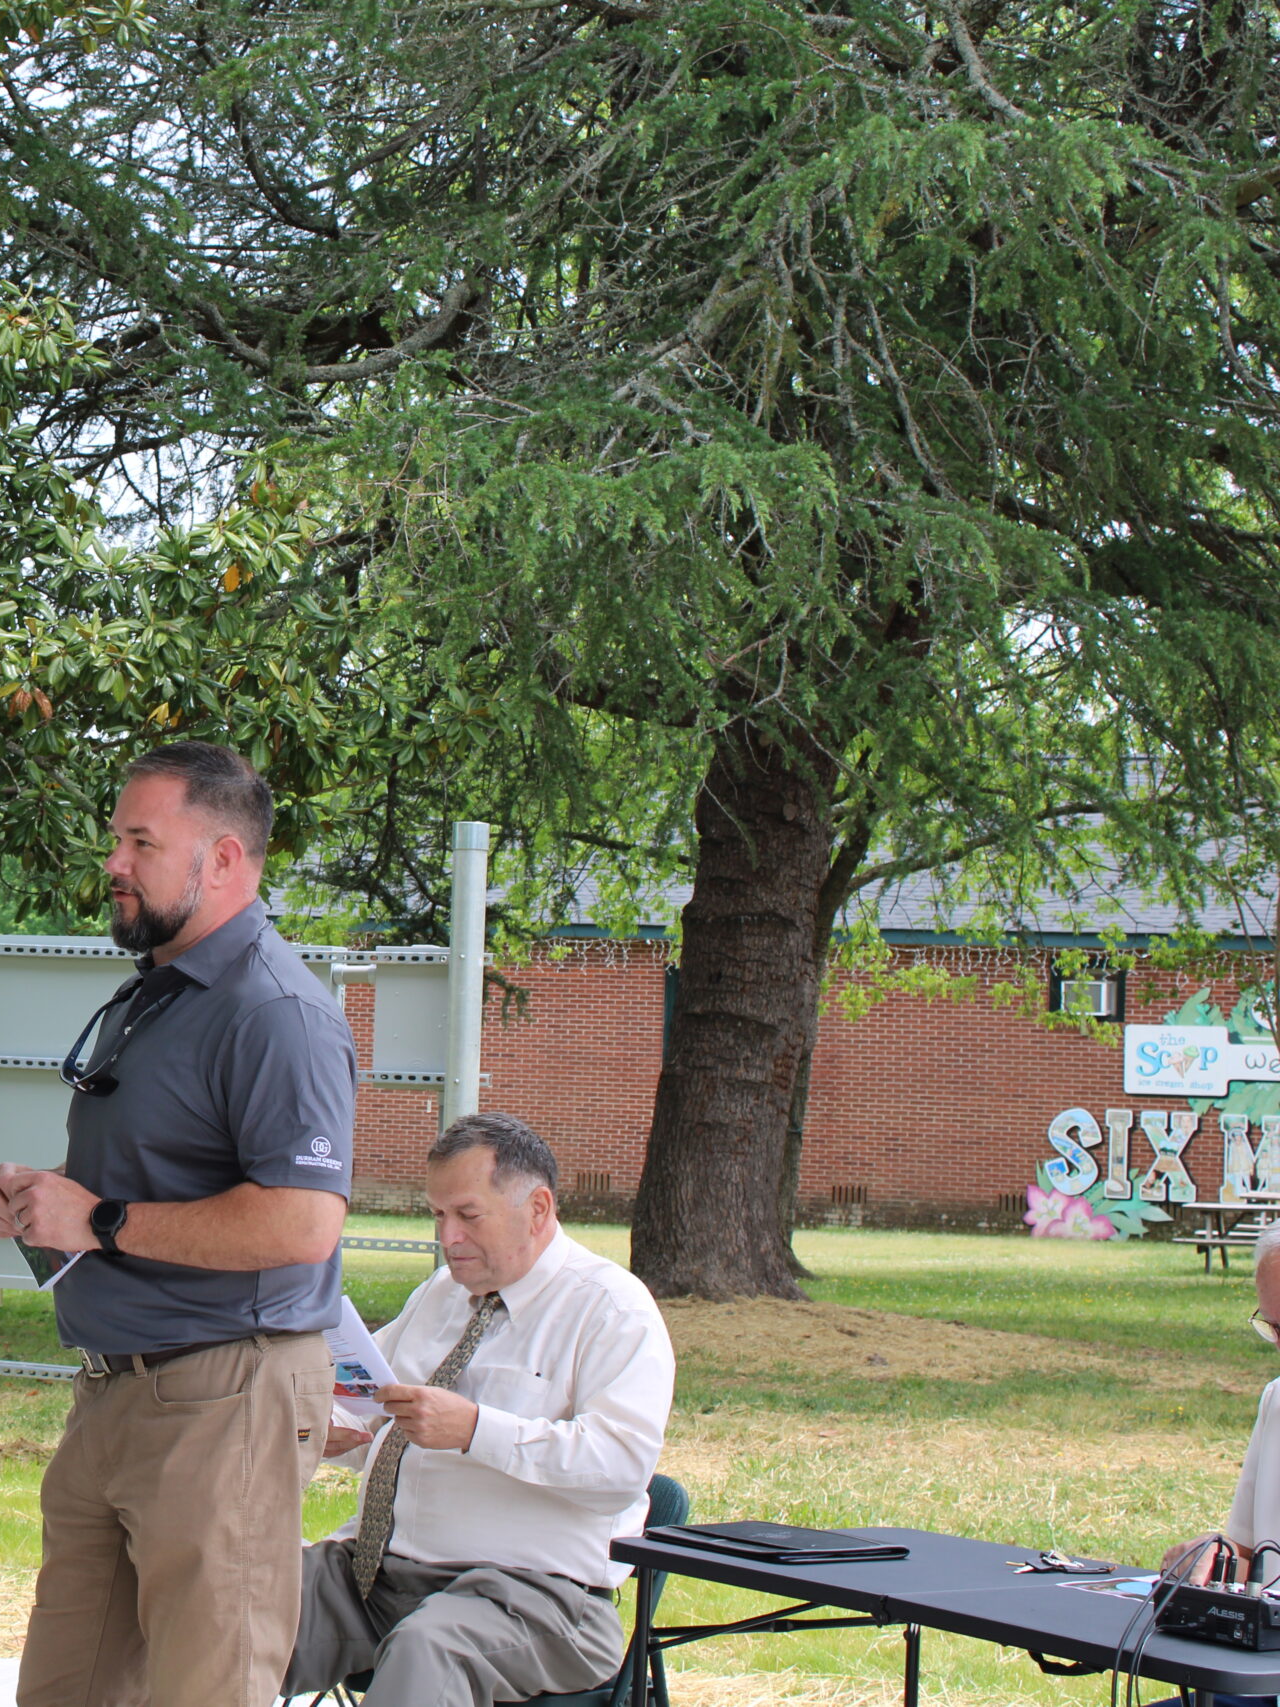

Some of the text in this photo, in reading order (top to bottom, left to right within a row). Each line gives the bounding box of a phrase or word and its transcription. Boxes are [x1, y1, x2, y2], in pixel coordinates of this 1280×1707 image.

[1160, 1033, 1186, 1046] the
[1155, 1080, 1185, 1089] cream
[1190, 1081, 1214, 1091] shop
[1045, 1108, 1198, 1202] SIX
[1207, 1606, 1246, 1621] ALESIS
